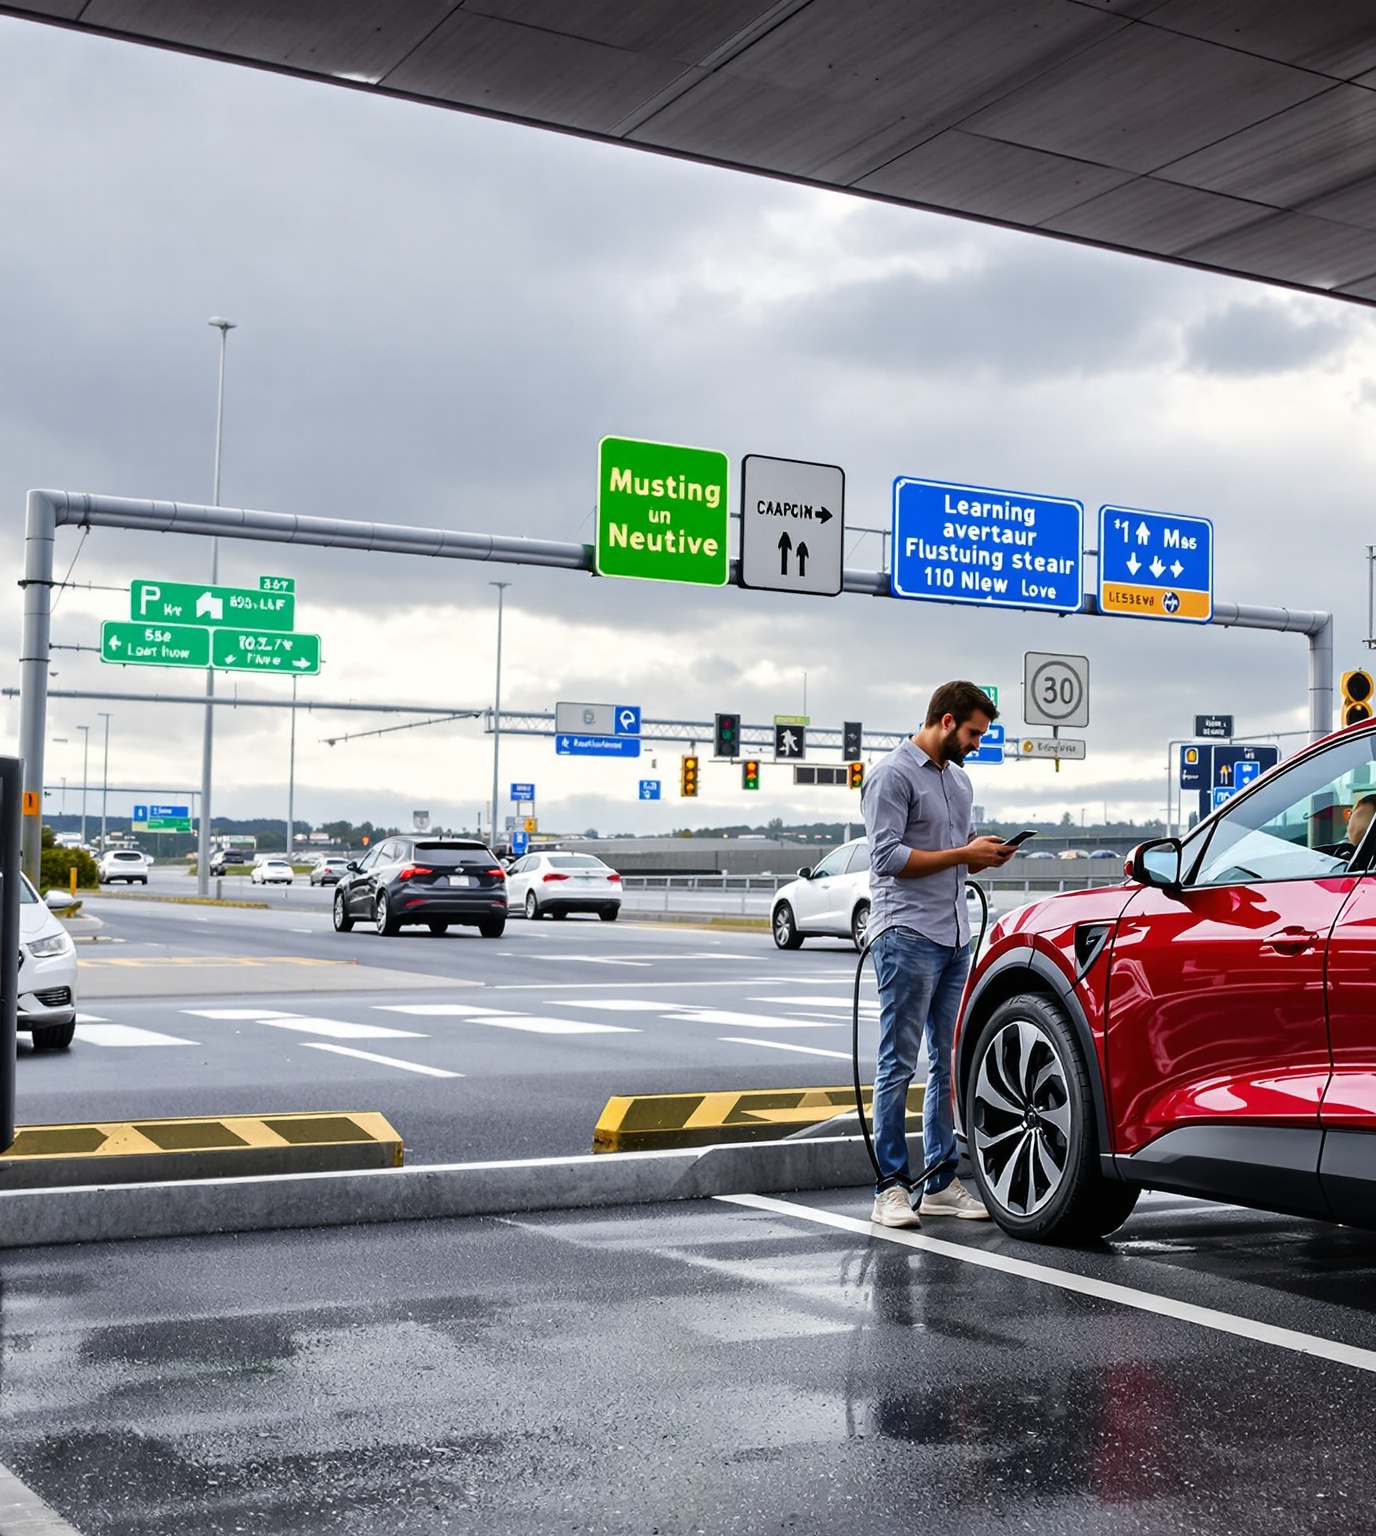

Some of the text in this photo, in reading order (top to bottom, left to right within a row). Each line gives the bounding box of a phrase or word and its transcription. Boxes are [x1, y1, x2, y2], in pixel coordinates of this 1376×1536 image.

[609, 466, 721, 508] Musting
[944, 494, 1036, 527] Learning
[608, 522, 719, 556] Neutive
[942, 522, 1037, 546] avertaur
[905, 537, 1003, 571] Flustuing
[924, 566, 954, 588] 110
[1021, 578, 1057, 599] Love
[140, 585, 161, 615] P
[1043, 676, 1074, 705] 30
